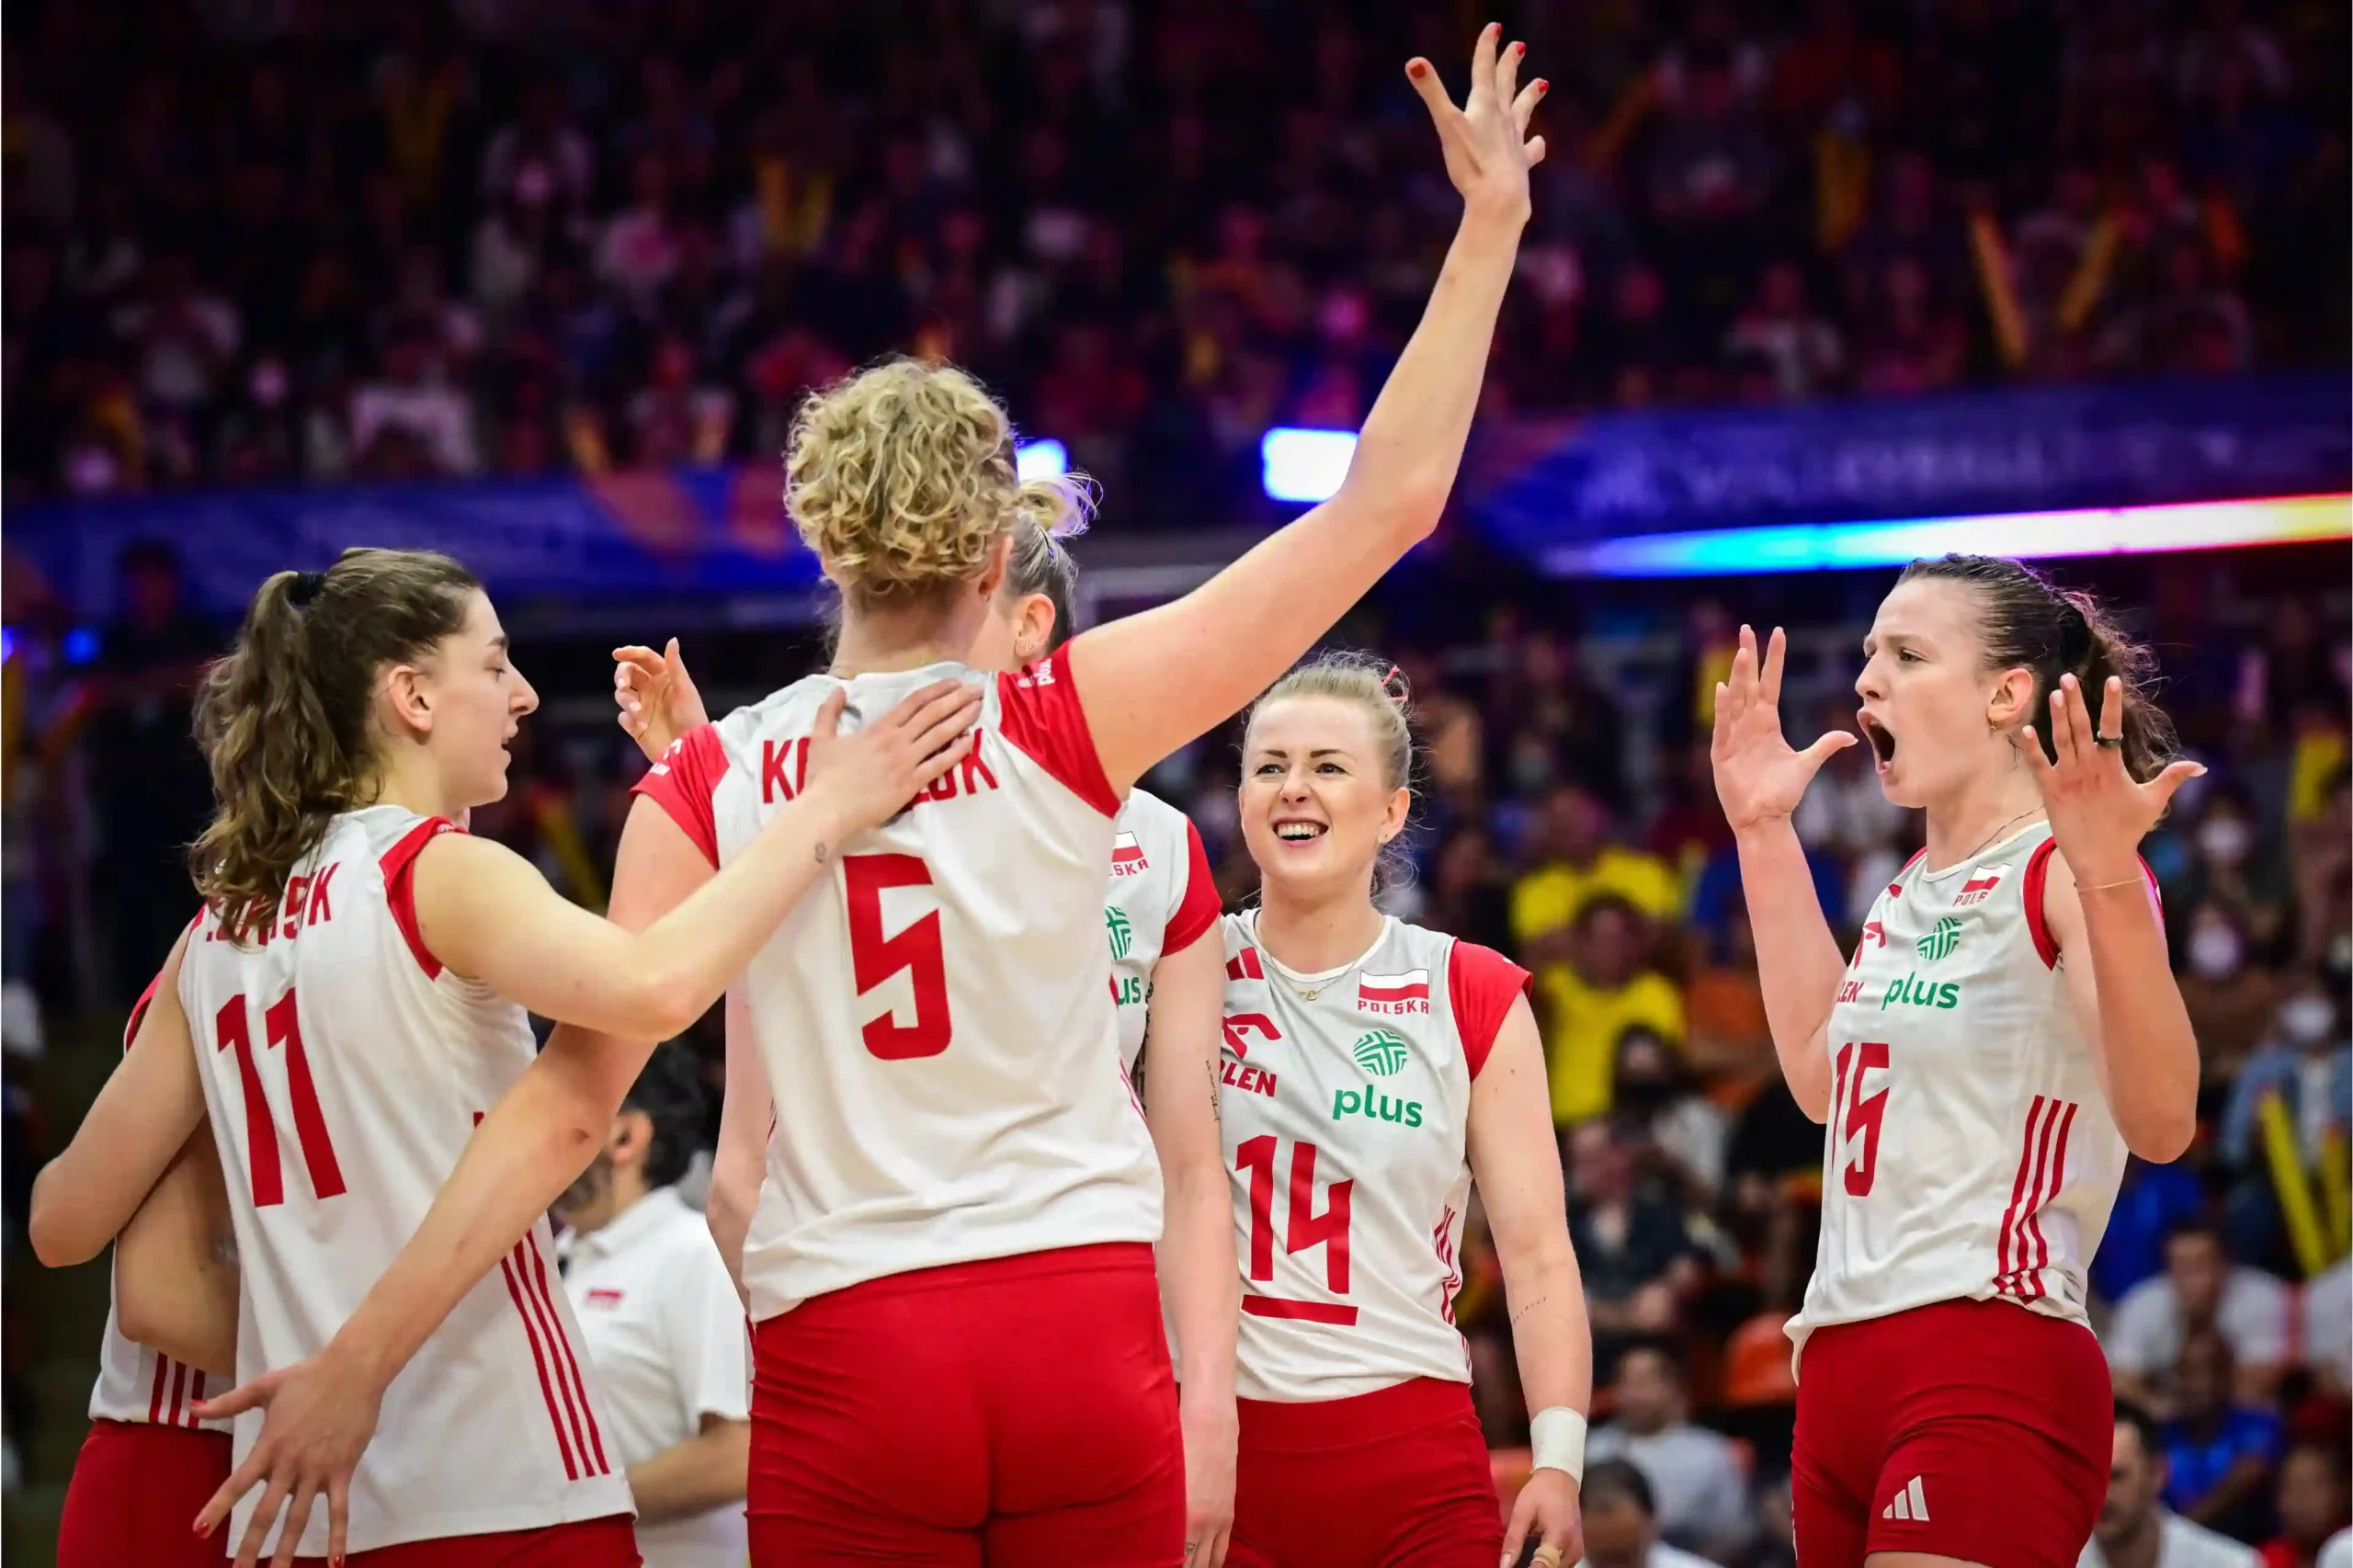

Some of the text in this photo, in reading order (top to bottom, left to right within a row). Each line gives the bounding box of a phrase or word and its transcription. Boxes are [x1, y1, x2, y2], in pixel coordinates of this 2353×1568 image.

[1110, 858, 1150, 877] SKA
[1952, 892, 1989, 907] POLS
[843, 853, 952, 1061] 5
[1117, 976, 1142, 1005] us
[1358, 999, 1430, 1015] POLSKA
[1881, 971, 1960, 1011] plus
[216, 986, 347, 1208] 11
[1221, 1059, 1278, 1098] LEN
[1332, 1085, 1424, 1129] plus
[1832, 1042, 1890, 1197] 15
[1235, 1134, 1355, 1296] 14
